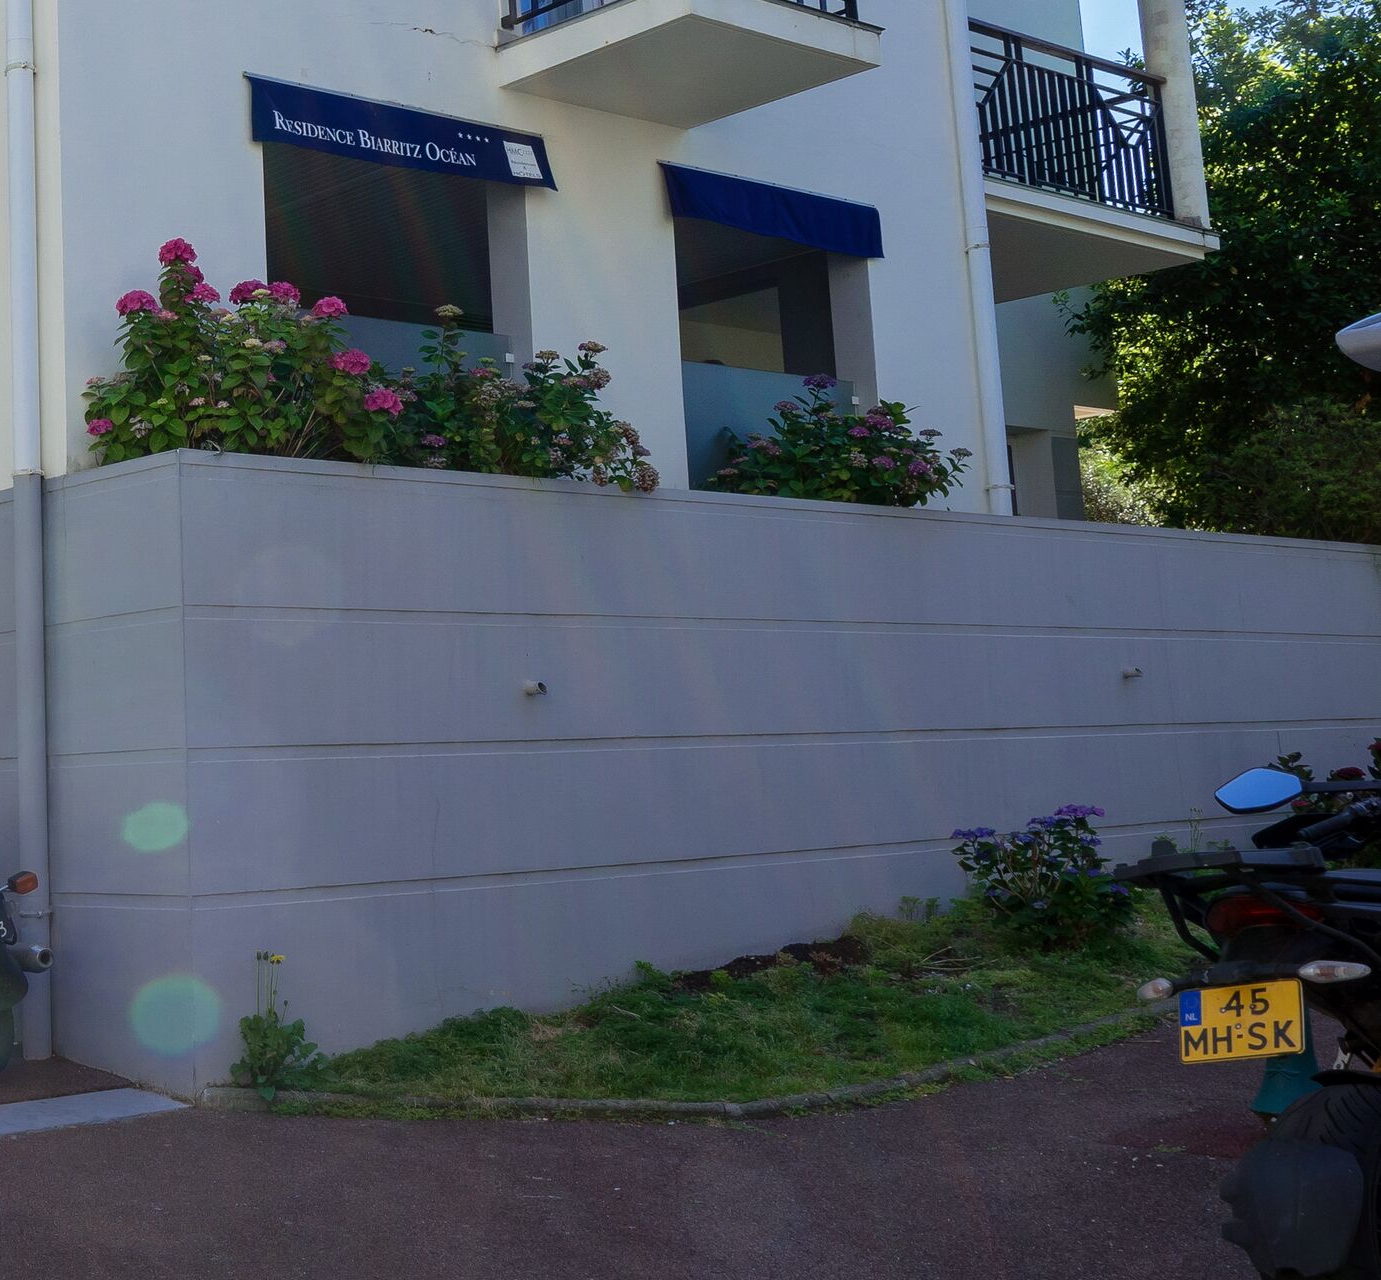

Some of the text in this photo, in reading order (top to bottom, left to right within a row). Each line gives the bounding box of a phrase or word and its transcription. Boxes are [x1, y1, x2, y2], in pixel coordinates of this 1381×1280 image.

[272, 110, 477, 167] RESIDENCE BIARRITZ OCÉAN
[1184, 1012, 1198, 1022] NL
[1221, 988, 1270, 1017] 45
[1183, 1020, 1296, 1057] MH-SK
